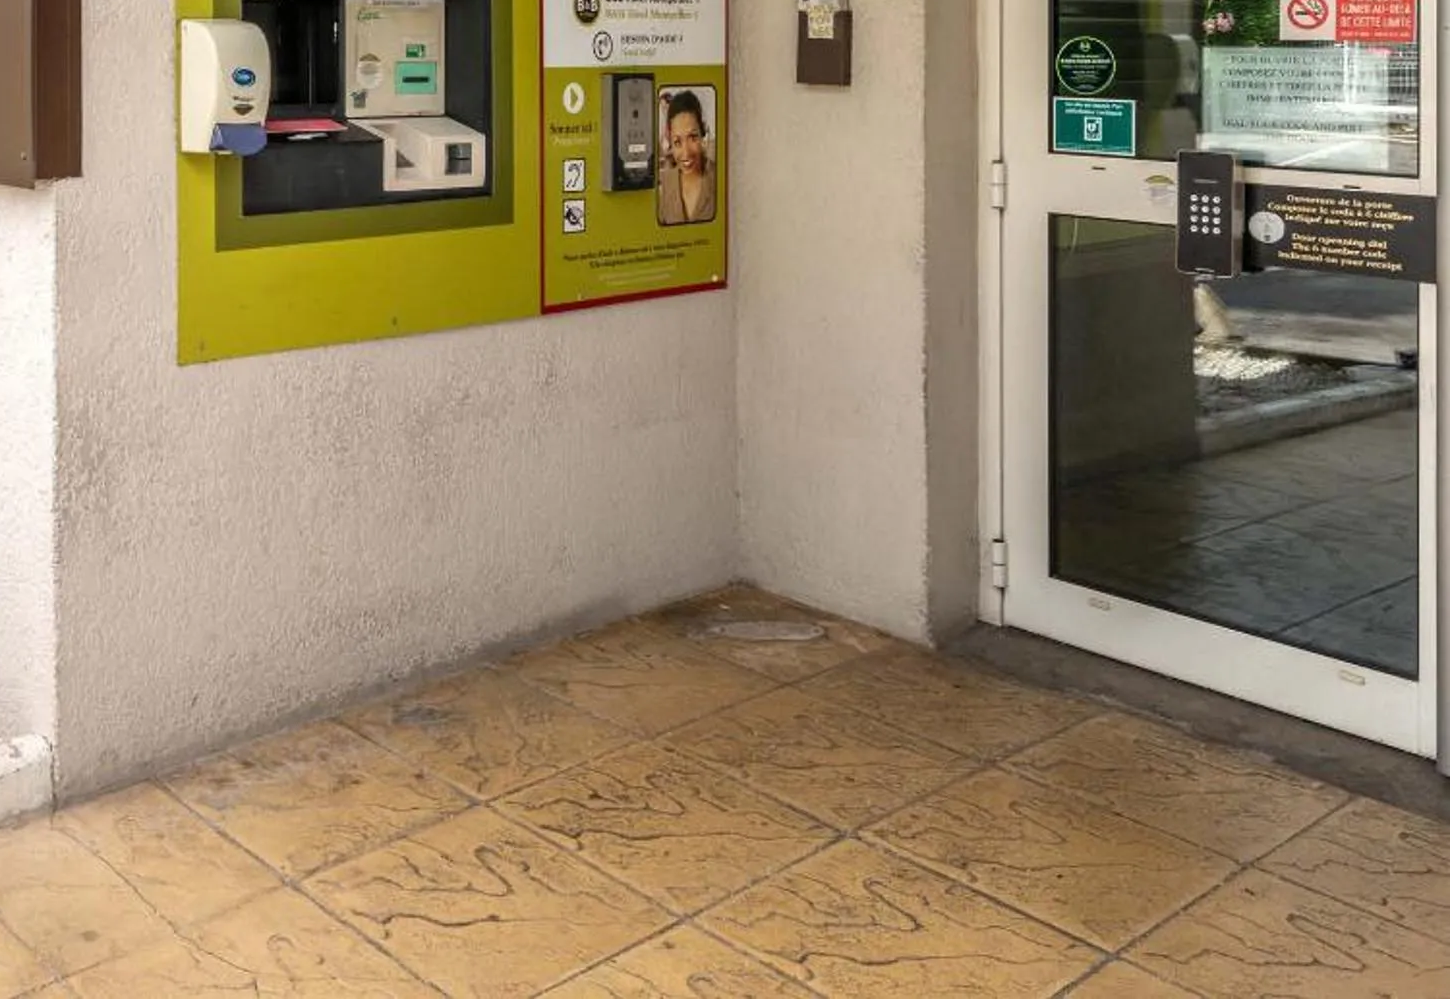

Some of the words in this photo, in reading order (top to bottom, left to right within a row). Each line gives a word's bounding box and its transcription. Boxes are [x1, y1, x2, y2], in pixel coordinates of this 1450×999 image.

[577, 0, 598, 12] B&B
[1338, 197, 1350, 206] de
[1352, 199, 1363, 208] la
[1364, 201, 1393, 210] porte
[1324, 217, 1340, 225] sur
[1291, 233, 1316, 243] Door
[1368, 239, 1387, 249] dial
[1322, 245, 1360, 256] number
[1340, 257, 1364, 267] your
[1366, 260, 1402, 271] receipt
